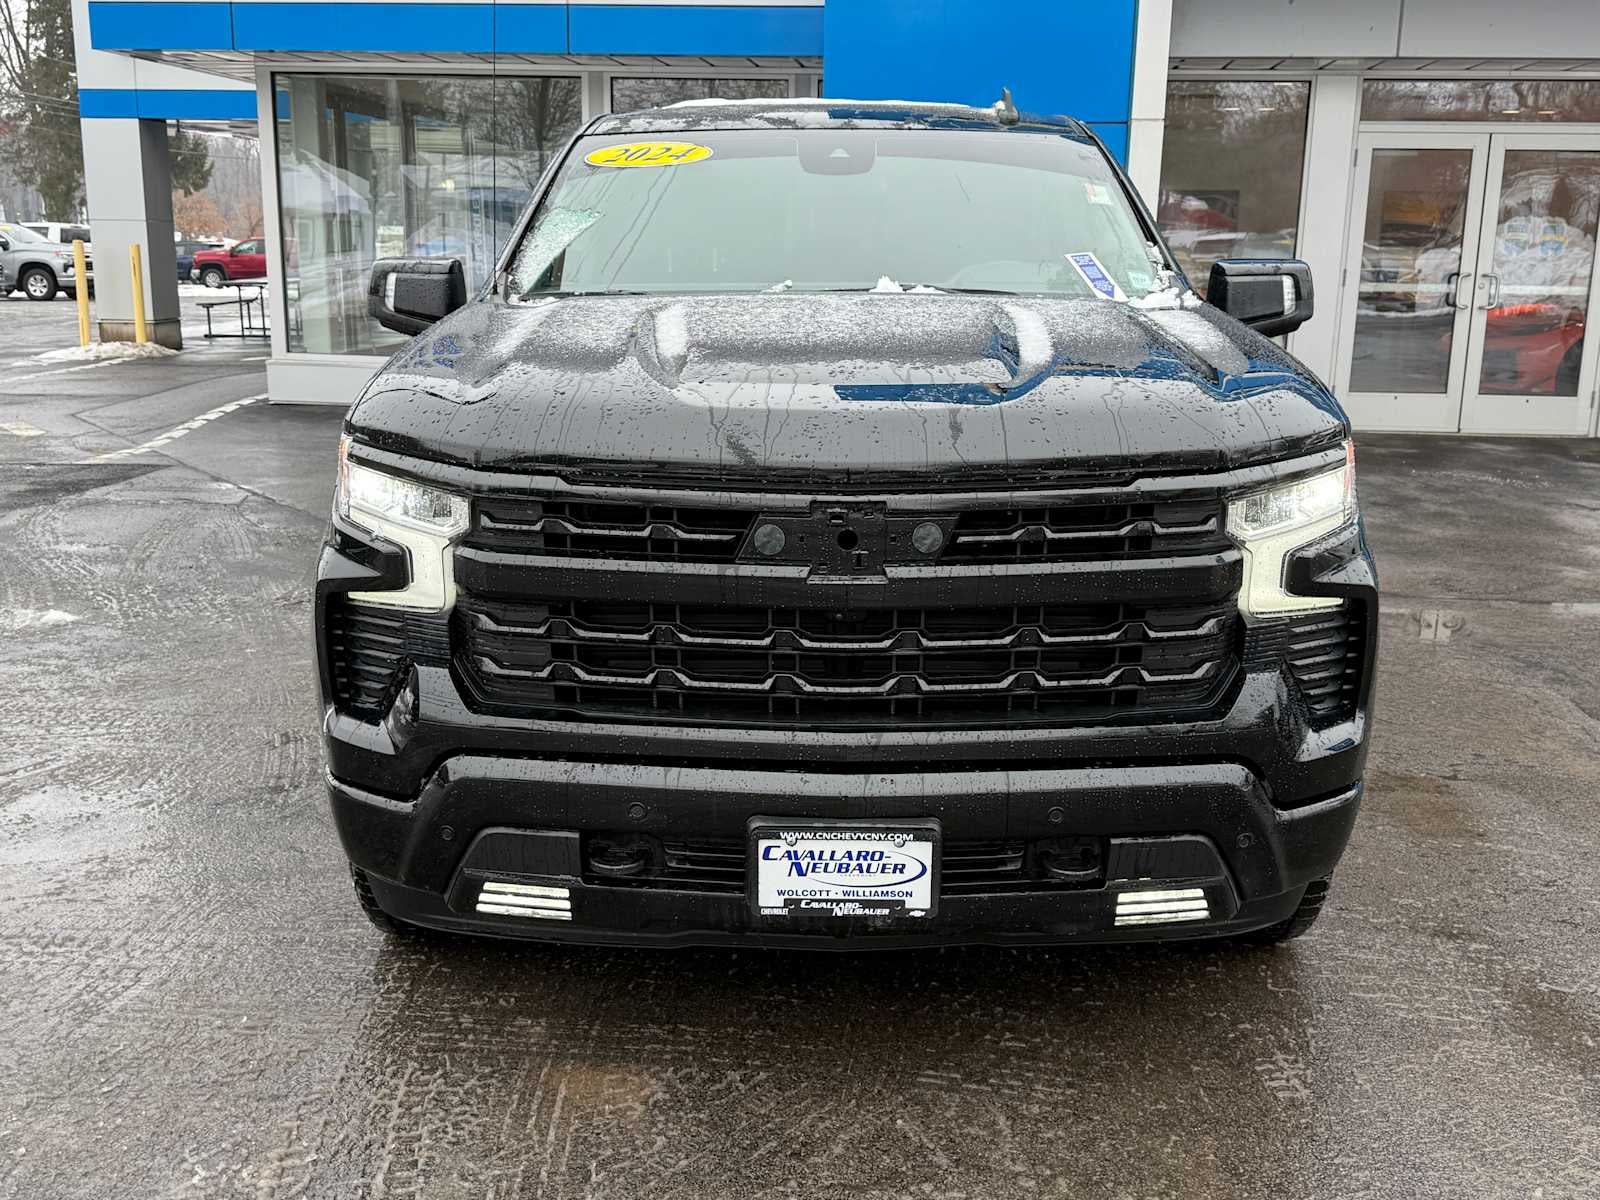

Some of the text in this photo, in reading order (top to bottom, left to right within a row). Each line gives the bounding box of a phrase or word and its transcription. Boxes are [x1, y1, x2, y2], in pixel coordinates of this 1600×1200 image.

[602, 146, 697, 163] 2024
[780, 832, 914, 841] WWW.CNCHEVYCNY.COM
[787, 861, 906, 877] NEUBAUER
[777, 889, 913, 898] WOLCOTT WILLIAMSON
[832, 908, 890, 917] NEUBAUER
